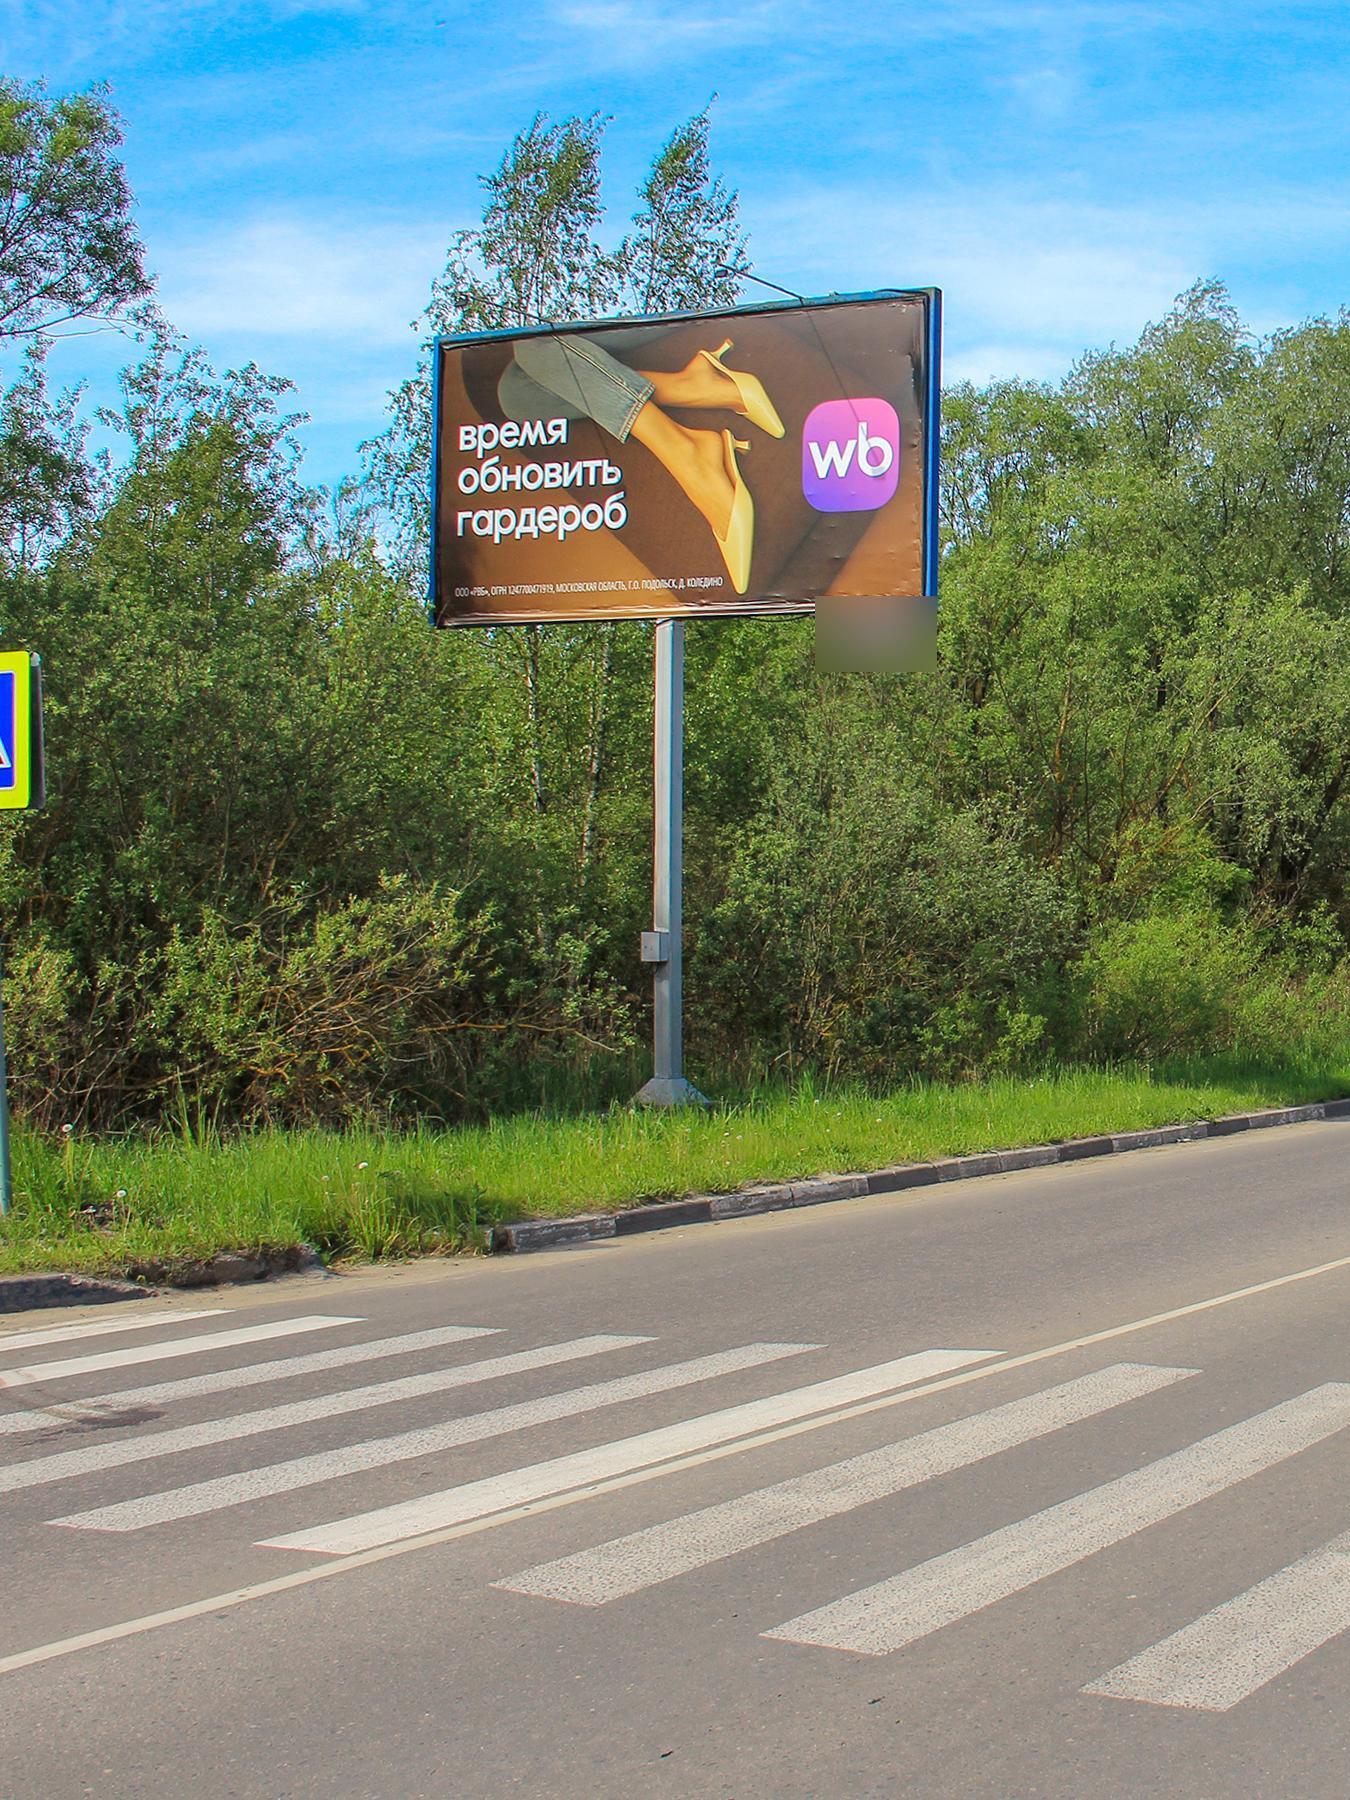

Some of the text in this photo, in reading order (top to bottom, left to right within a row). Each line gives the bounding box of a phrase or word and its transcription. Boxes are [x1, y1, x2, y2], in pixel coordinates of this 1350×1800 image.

[459, 418, 569, 459] время
[808, 421, 894, 479] wb
[458, 455, 623, 495] обновить
[457, 491, 629, 545] гардероб
[454, 587, 470, 598] ООО
[491, 585, 507, 596] ОГРН
[556, 582, 597, 593] МОСКОВСКАЯ
[598, 580, 628, 592] ОБЛАСТЬ,
[641, 577, 678, 591] ПОДОЛЬСК,
[687, 576, 723, 589] КОЛЕДИНО
